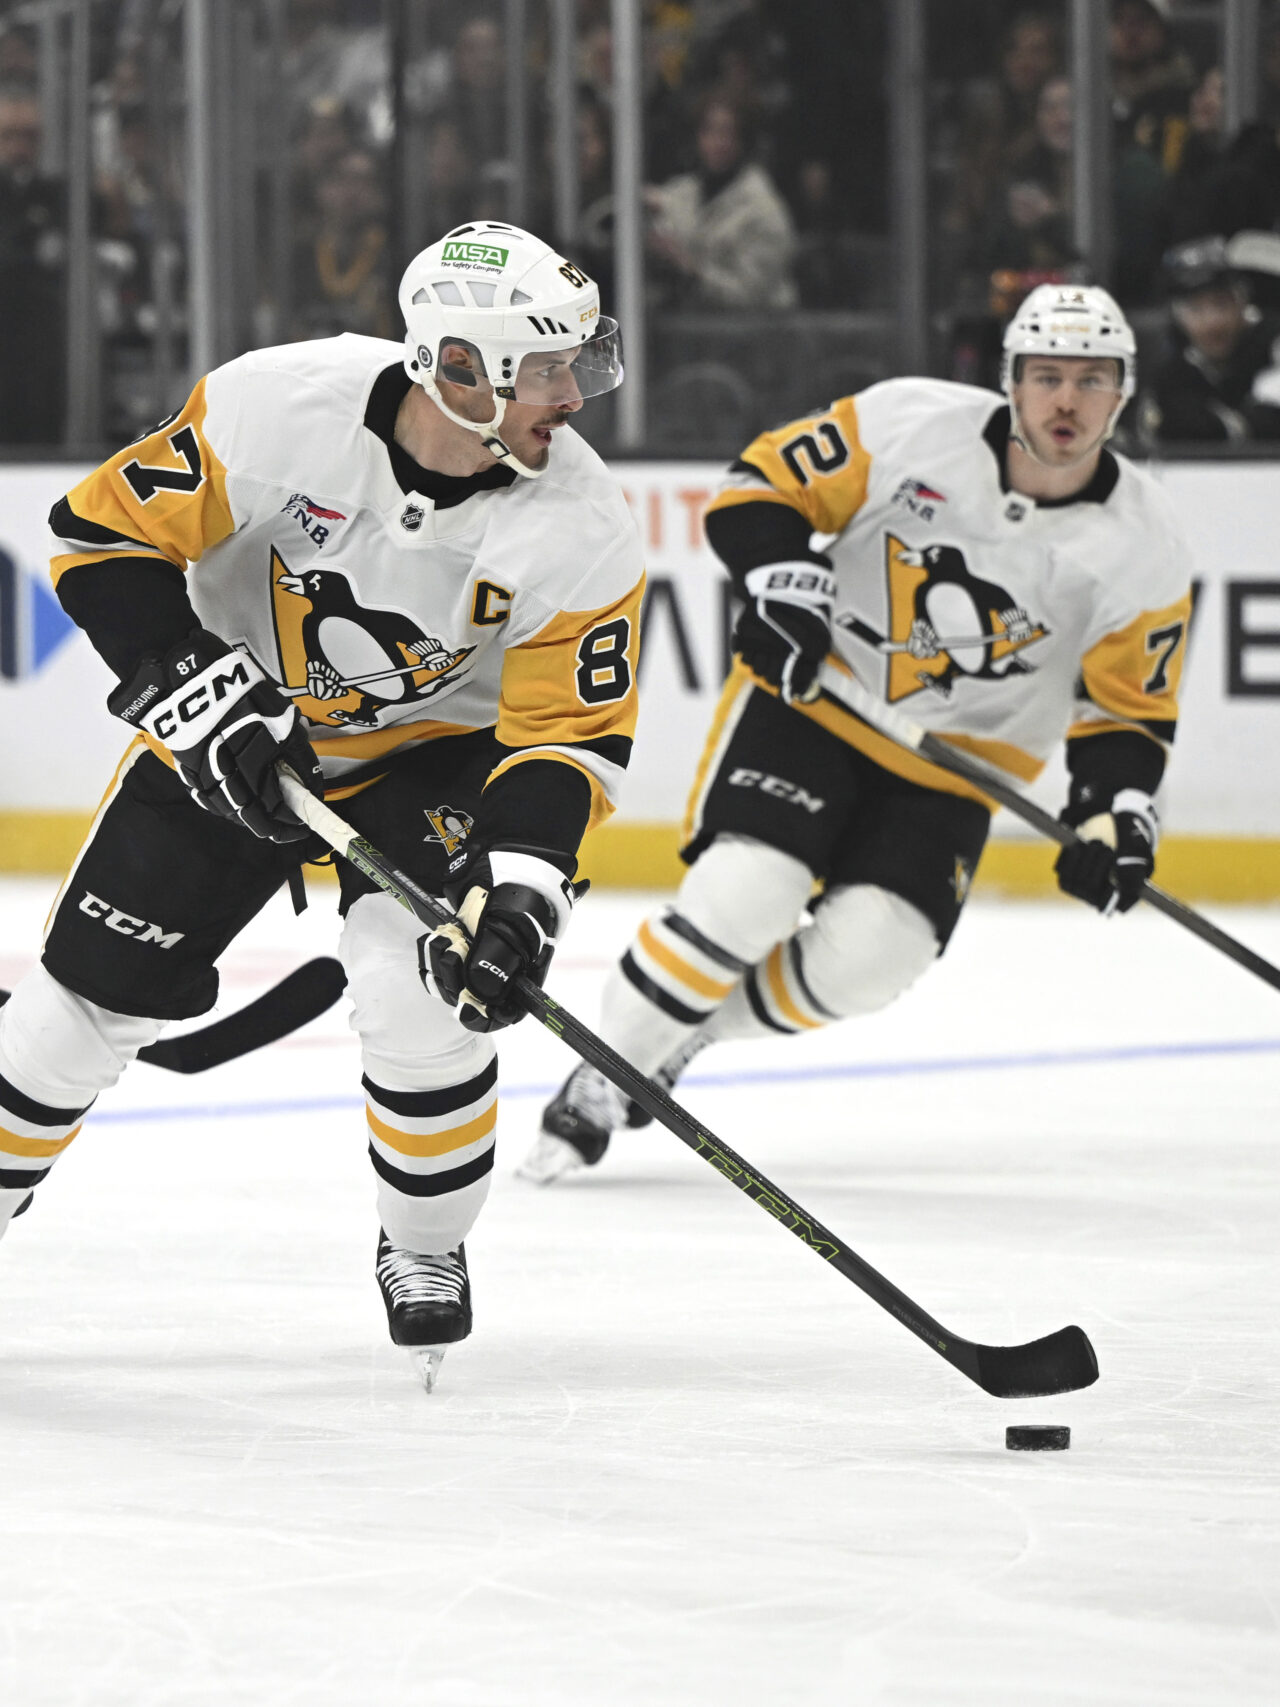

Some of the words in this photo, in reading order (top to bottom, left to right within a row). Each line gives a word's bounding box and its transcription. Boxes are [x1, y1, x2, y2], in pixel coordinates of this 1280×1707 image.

[444, 243, 503, 265] MSA
[452, 261, 472, 270] Safety
[472, 263, 503, 275] Company
[558, 261, 589, 289] 87
[118, 413, 207, 506] 7
[778, 413, 856, 488] 2
[471, 580, 515, 627] C
[176, 653, 198, 676] 87
[575, 615, 632, 707] 8
[1144, 620, 1187, 696] 7
[121, 684, 159, 720] PENGUINS
[153, 662, 250, 740] CCM
[728, 768, 825, 814] CCM
[352, 855, 401, 899] CCM
[449, 853, 468, 869] CCM
[79, 890, 185, 949] CCM
[478, 959, 509, 983] CCM
